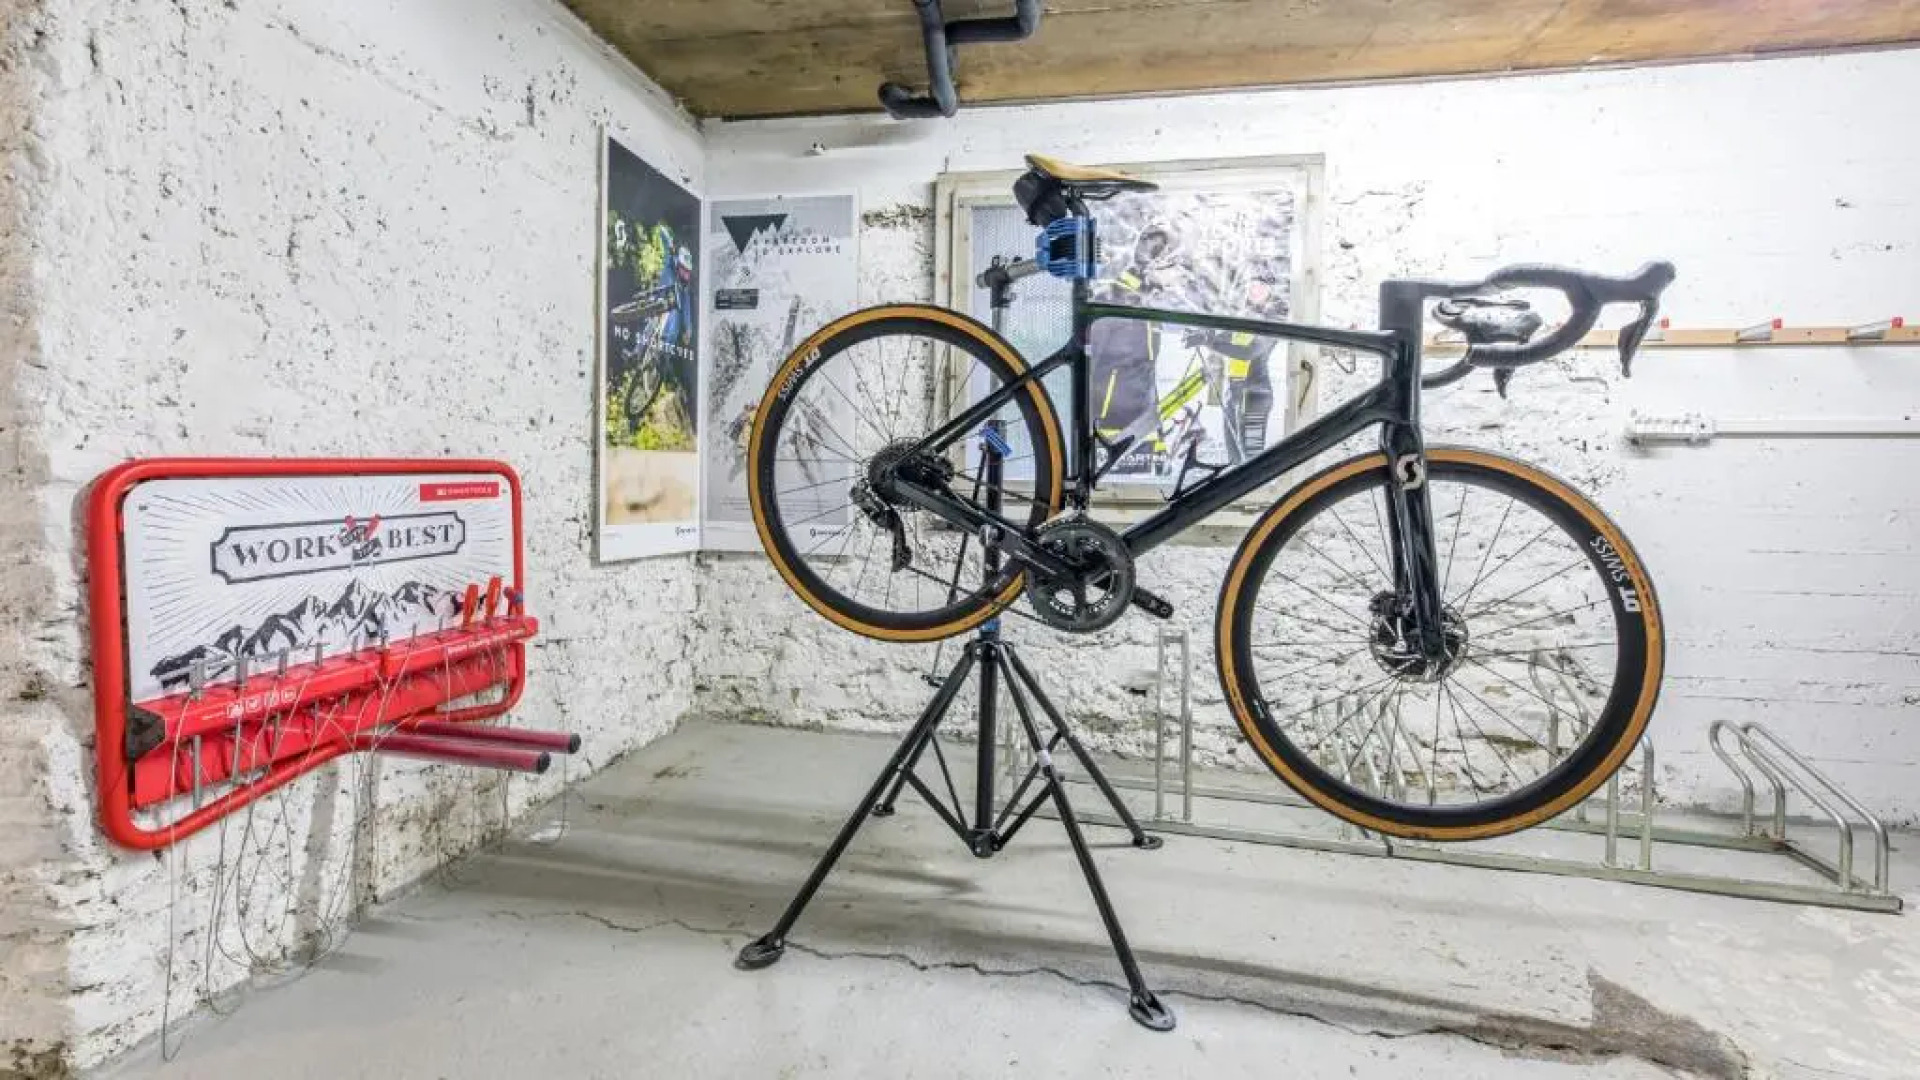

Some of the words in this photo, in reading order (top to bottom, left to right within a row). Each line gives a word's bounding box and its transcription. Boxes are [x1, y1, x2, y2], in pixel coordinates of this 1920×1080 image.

[614, 325, 630, 341] NO
[231, 535, 337, 567] WORK
[388, 524, 455, 549] BEST
[1589, 535, 1630, 583] SWISS
[1617, 586, 1642, 613] DT
